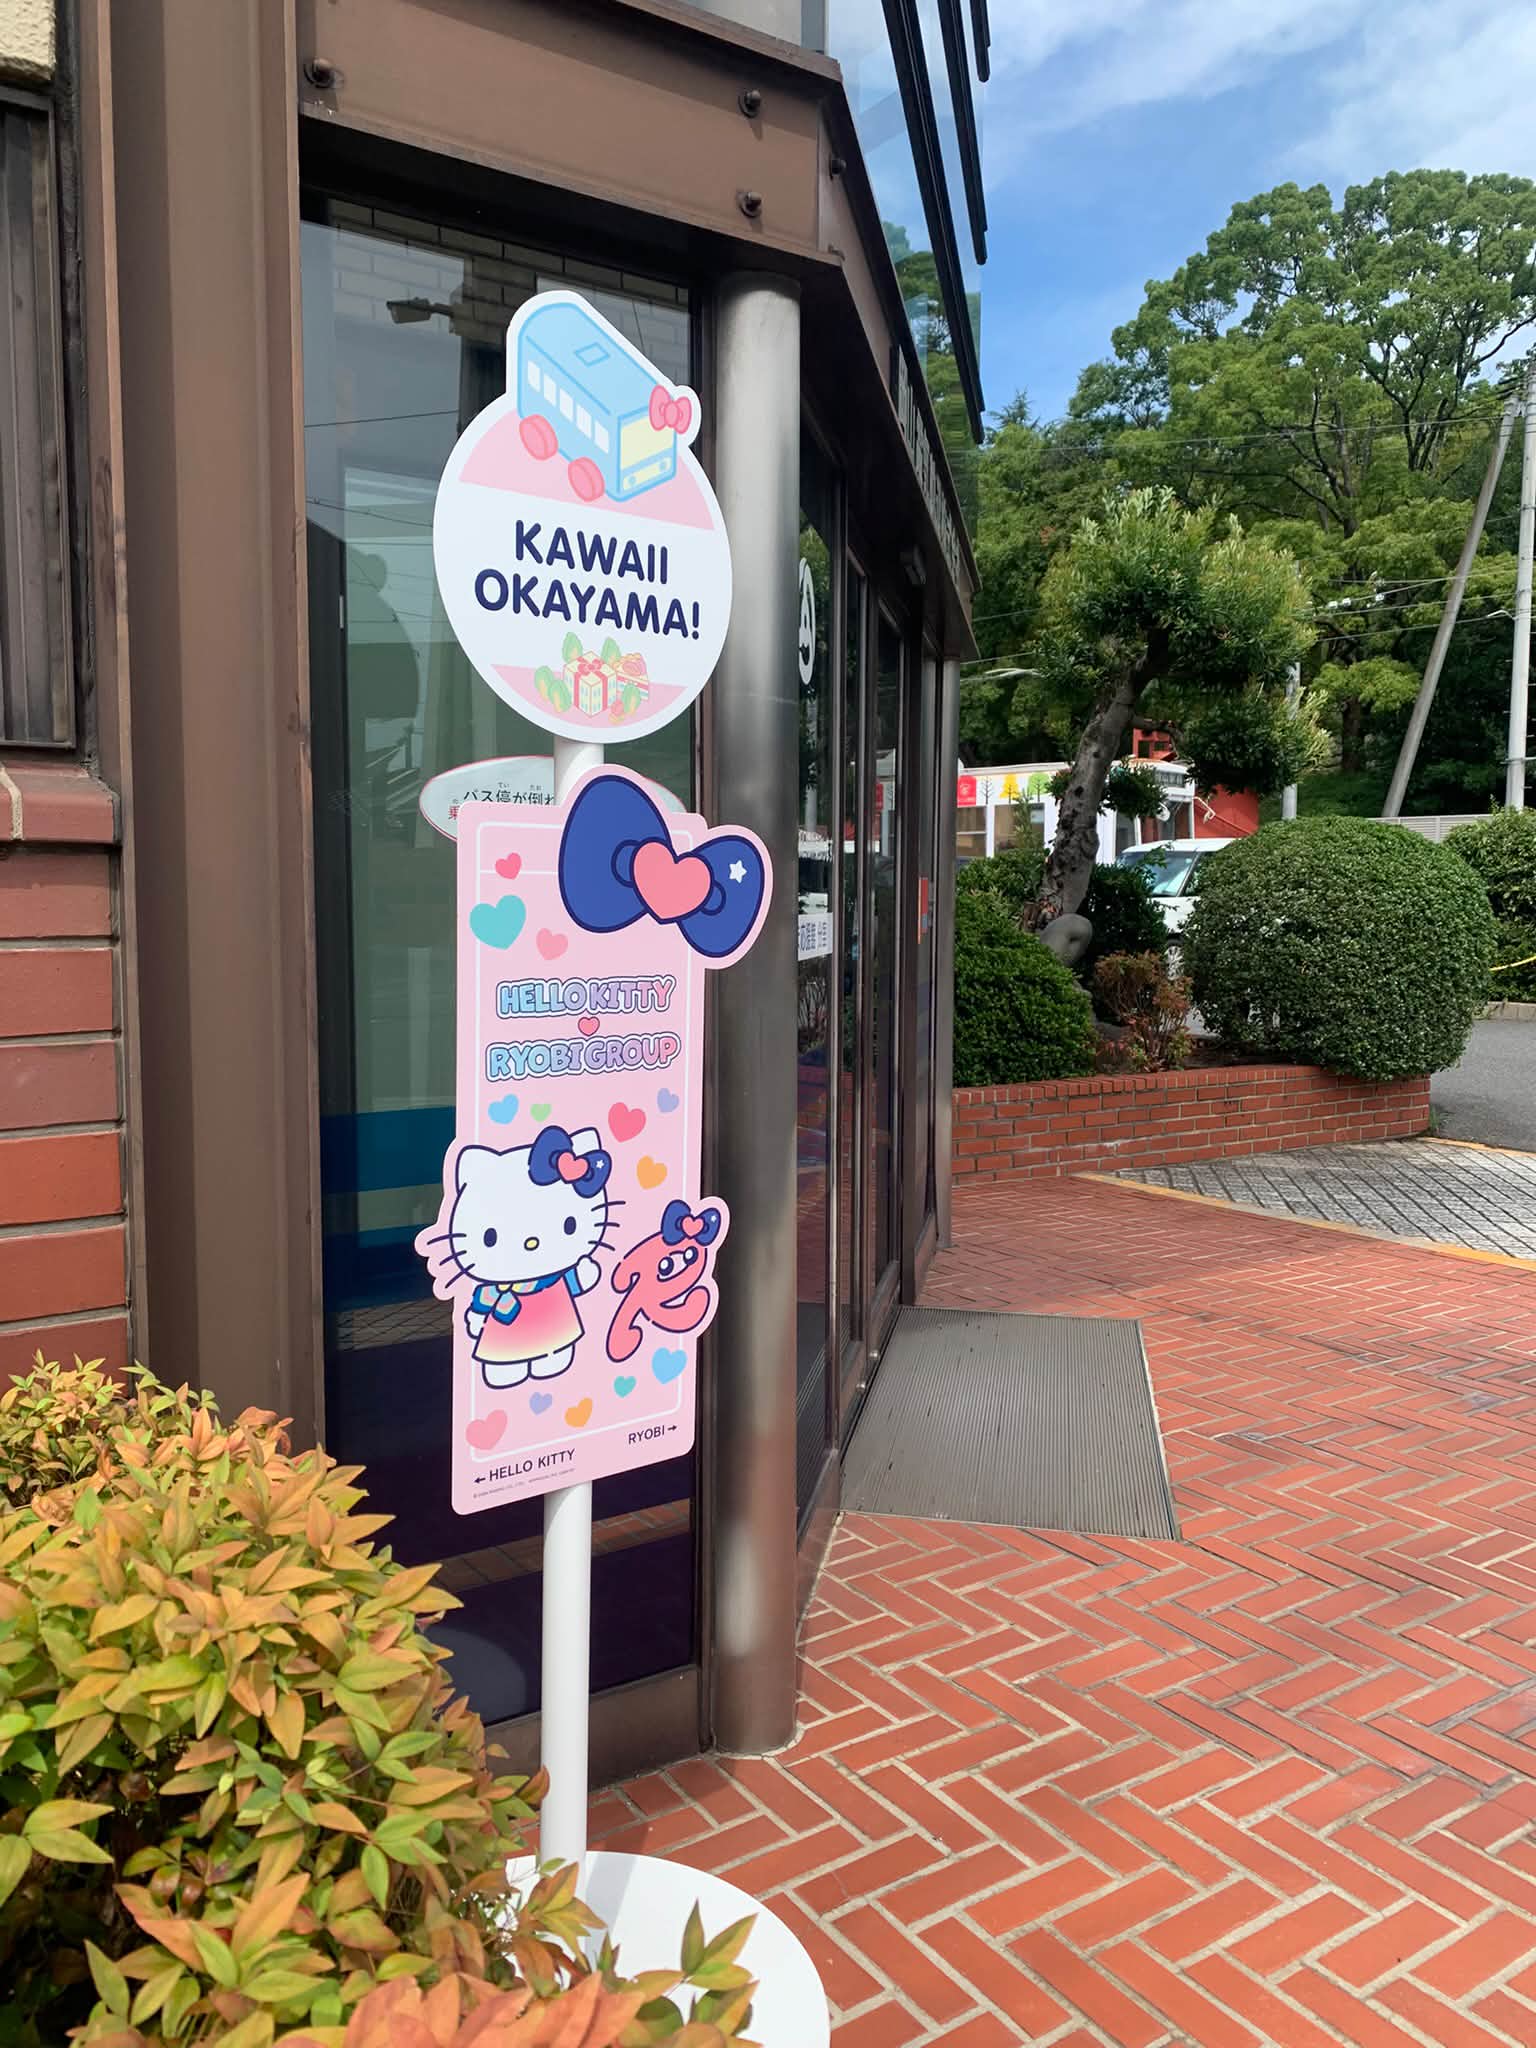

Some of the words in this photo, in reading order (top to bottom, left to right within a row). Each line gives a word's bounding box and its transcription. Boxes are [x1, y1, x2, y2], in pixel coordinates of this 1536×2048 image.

[515, 519, 669, 585] KAWAII
[474, 568, 700, 640] OKAYAMA!
[498, 980, 587, 1016] HELLO
[588, 977, 674, 1012] KITTY
[488, 1043, 583, 1079] RYOBI
[584, 1035, 679, 1071] GROUP
[628, 1425, 665, 1444] RYOBI
[489, 1460, 533, 1481] HELLO
[538, 1448, 576, 1468] KITTY
